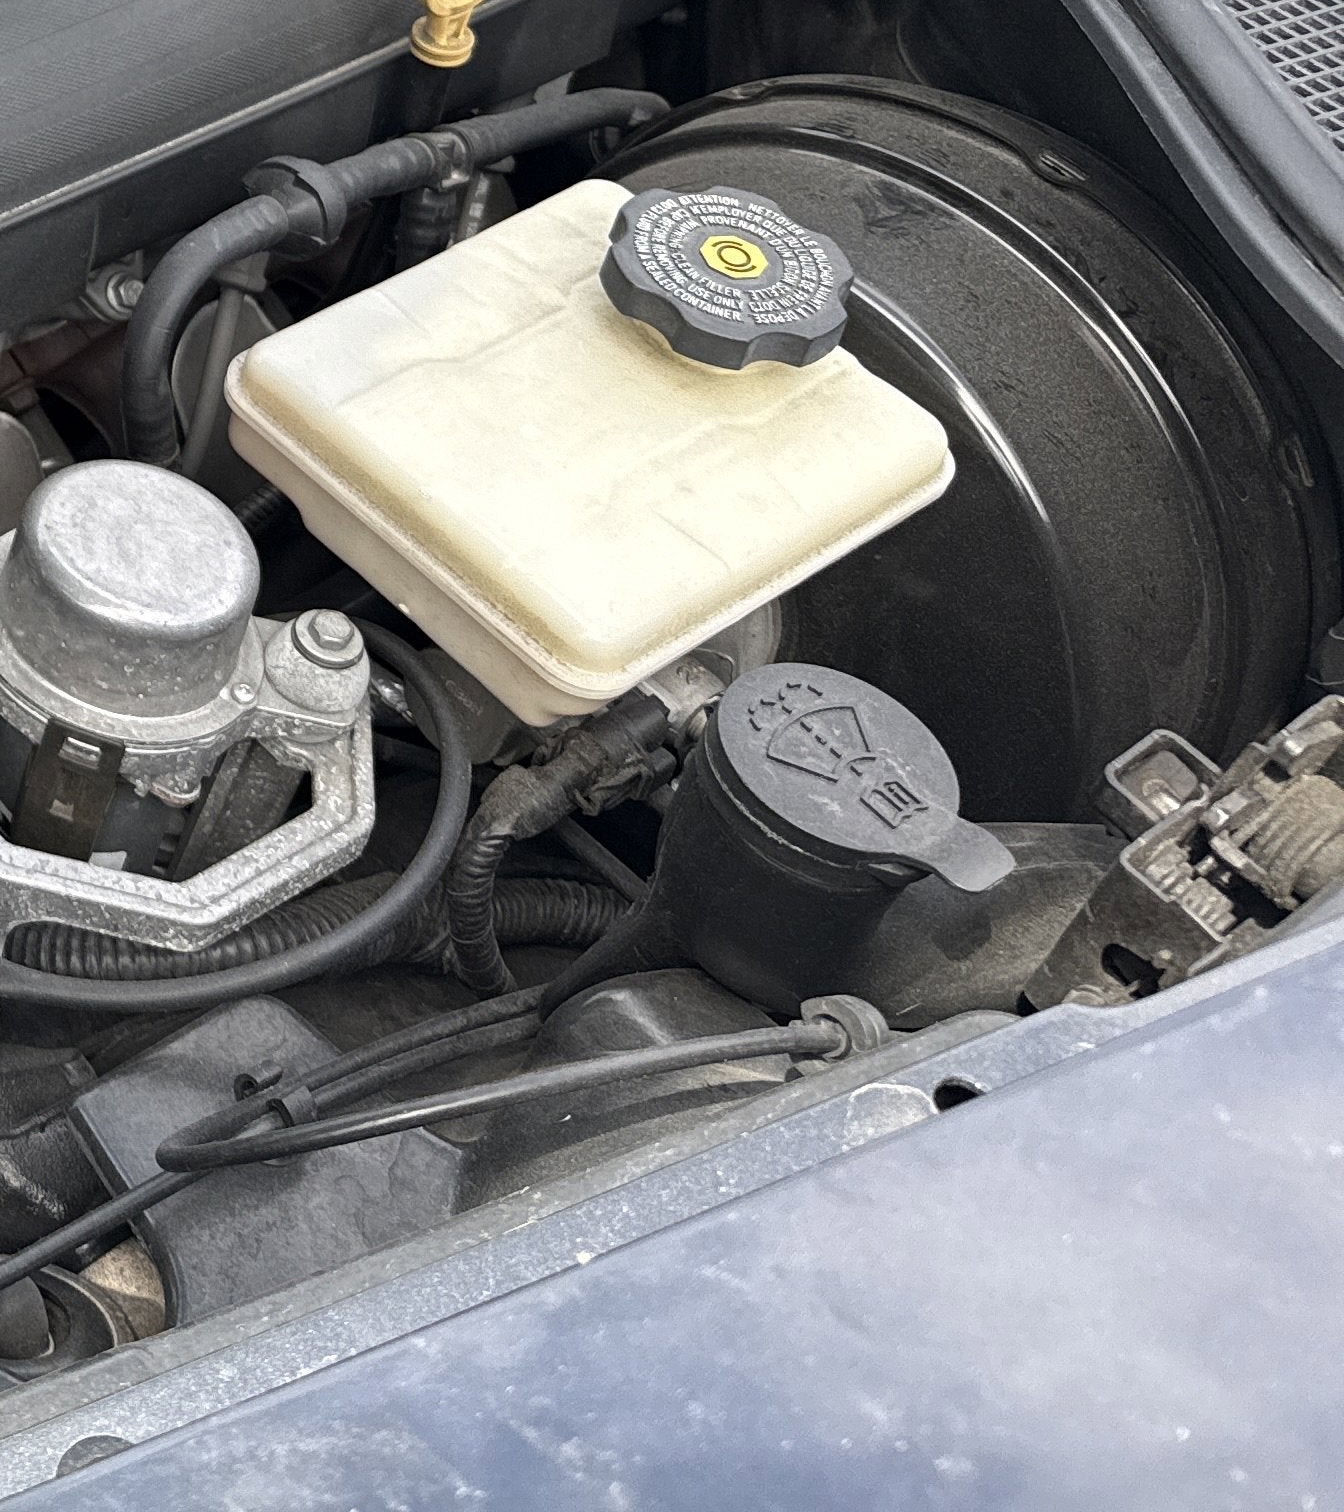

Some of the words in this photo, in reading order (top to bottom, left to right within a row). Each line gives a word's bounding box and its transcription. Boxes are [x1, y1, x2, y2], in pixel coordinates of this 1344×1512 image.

[698, 215, 773, 238] PROVENANT
[760, 218, 789, 236] QUE
[798, 234, 819, 247] LE
[640, 261, 678, 291] SEALED
[671, 252, 701, 280] CLEAN
[695, 276, 743, 299] FILLER
[685, 282, 713, 301] USE
[711, 293, 745, 310] ONLY
[793, 303, 817, 318] LA
